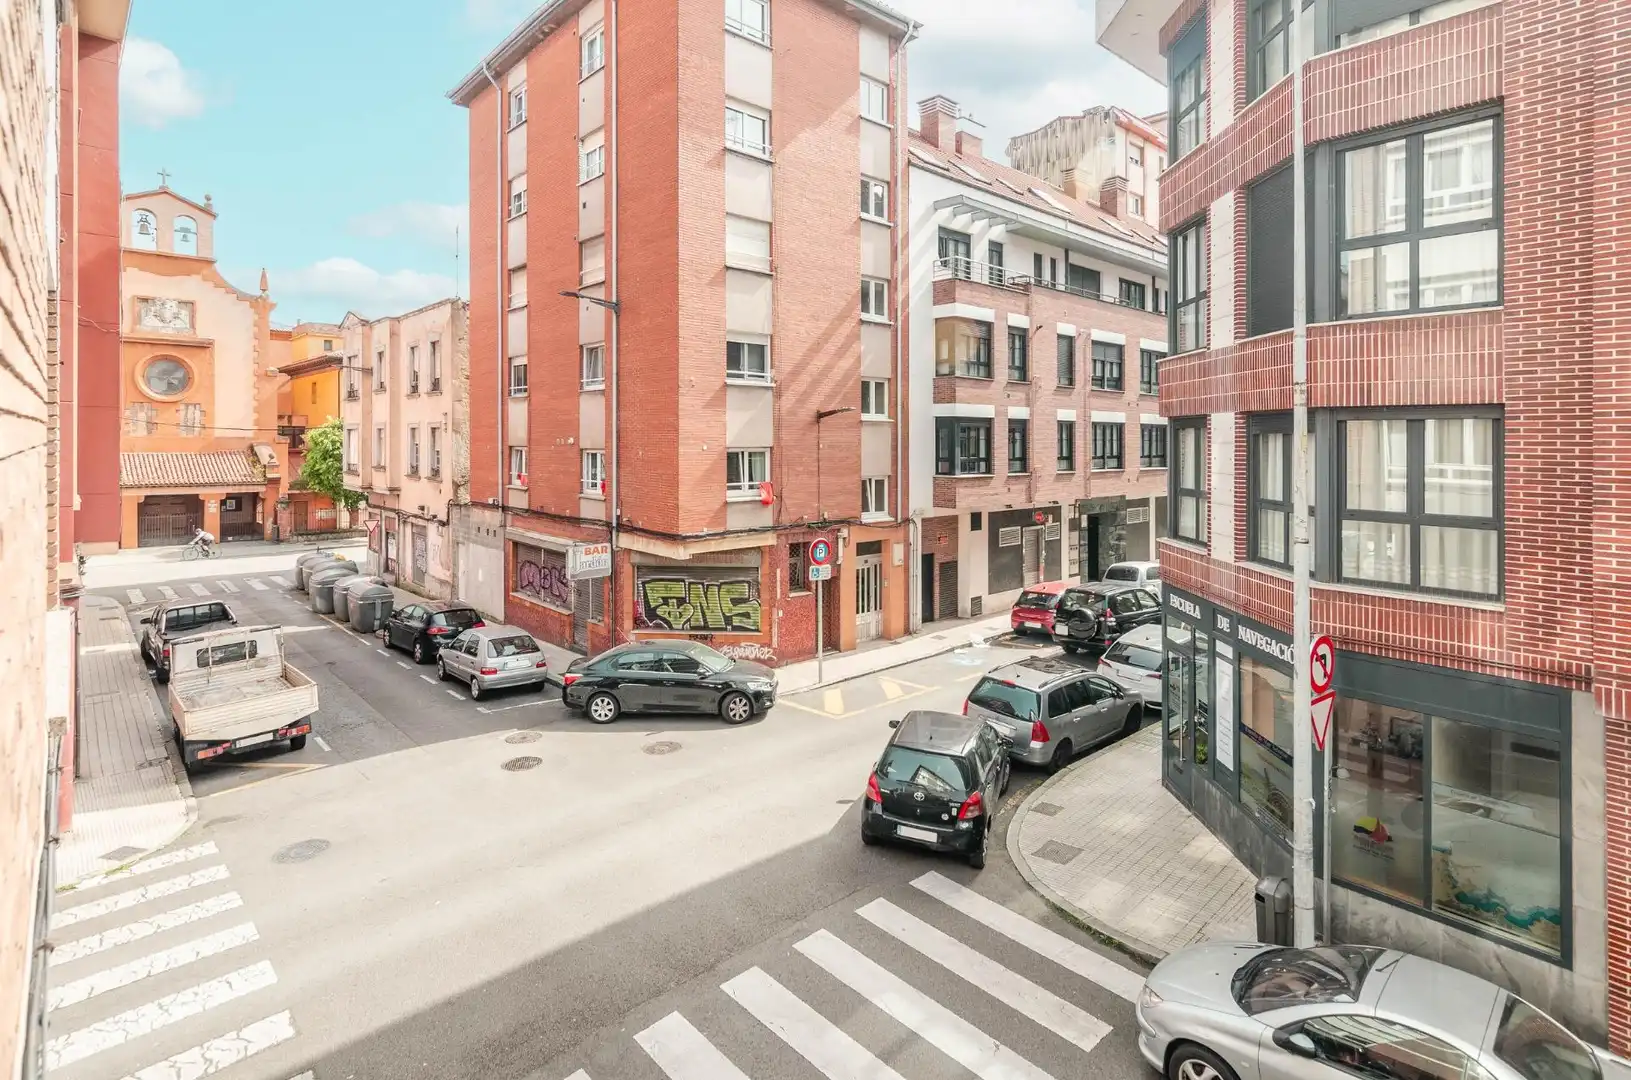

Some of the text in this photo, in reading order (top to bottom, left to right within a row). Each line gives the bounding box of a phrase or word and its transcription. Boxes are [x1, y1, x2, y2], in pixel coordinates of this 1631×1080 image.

[584, 545, 609, 556] BAR
[1169, 593, 1295, 665] ESCUELA DE NAVEGACIÓ
